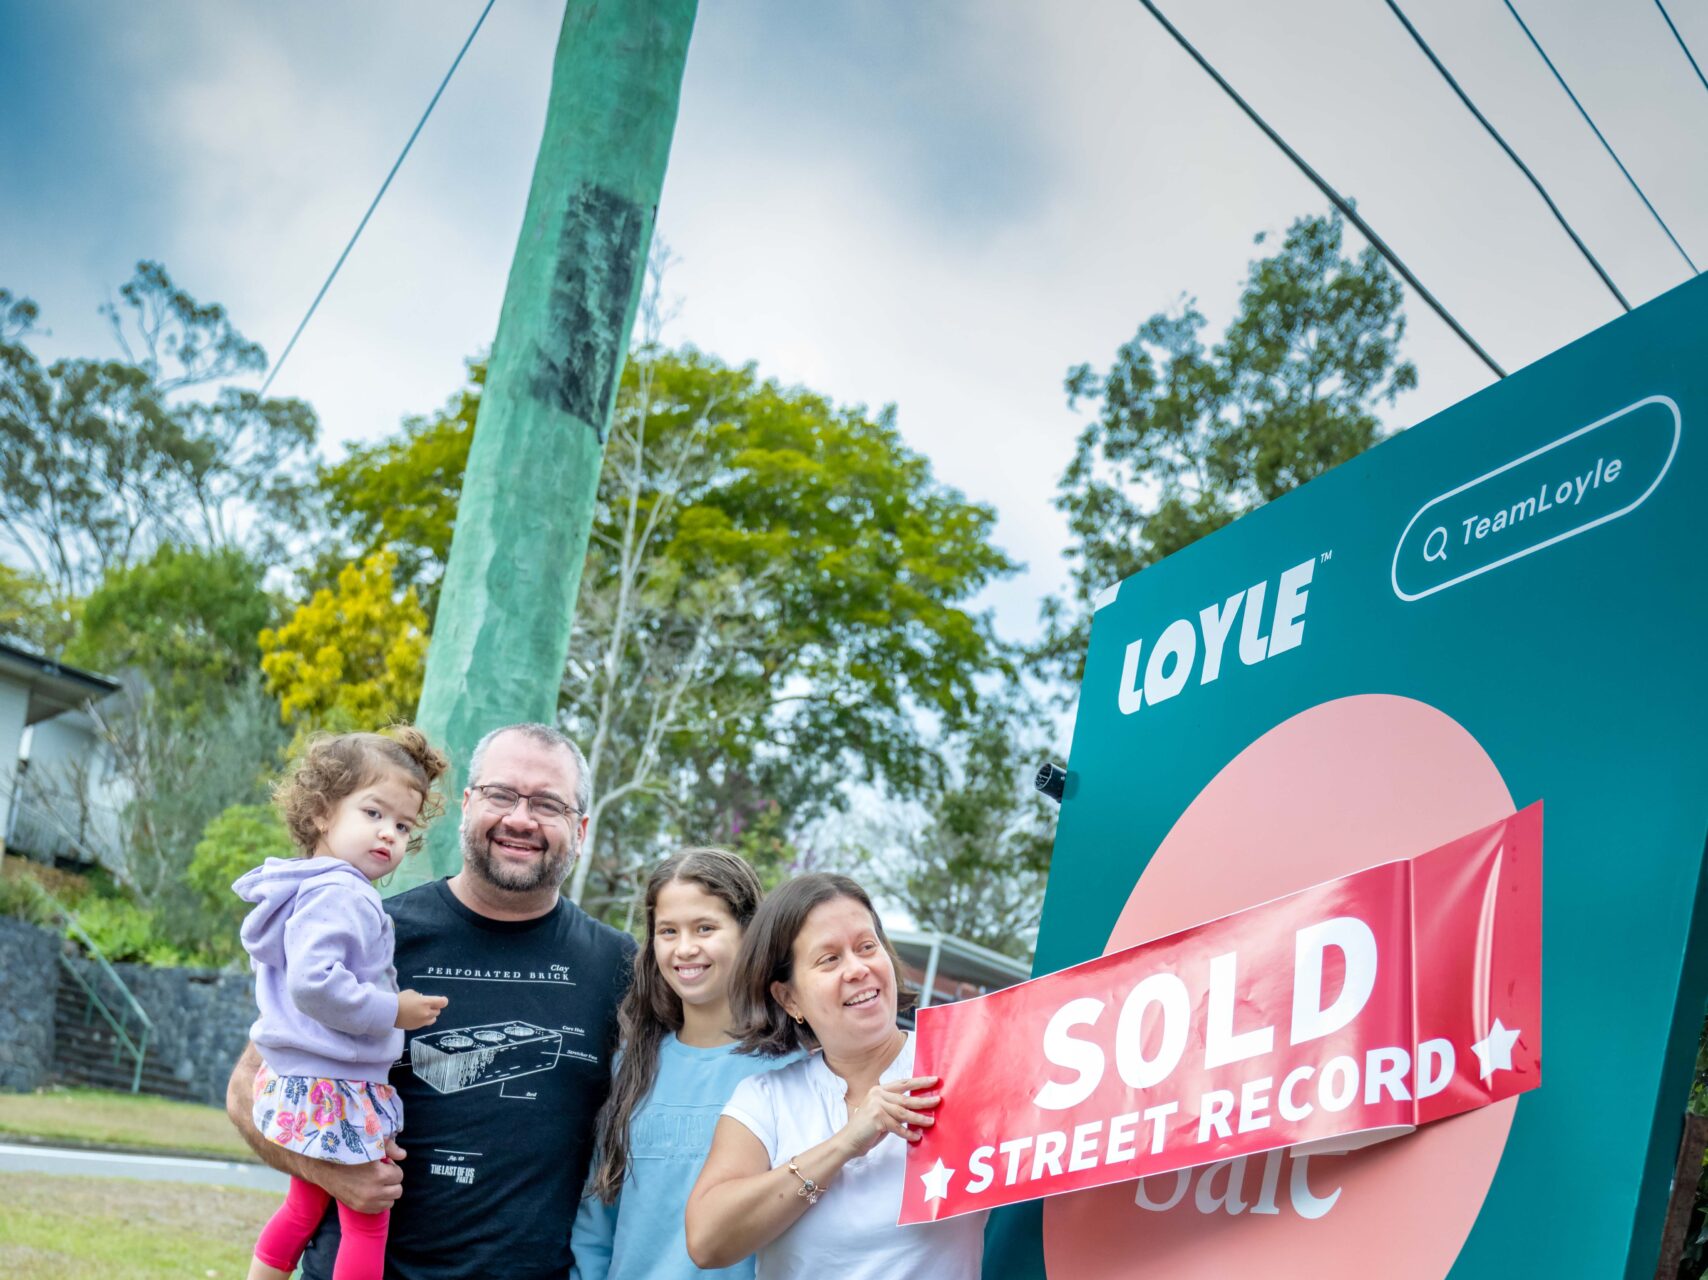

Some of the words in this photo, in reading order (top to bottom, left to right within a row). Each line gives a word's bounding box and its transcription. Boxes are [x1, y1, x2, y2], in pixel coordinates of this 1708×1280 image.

[1462, 457, 1623, 546] TeamLoyle
[1119, 556, 1316, 715] LOYLE
[427, 966, 521, 979] PERFORATED
[529, 972, 569, 981] BRICK
[550, 964, 570, 973] Clay
[1033, 916, 1378, 1111] SOLD
[965, 1101, 1178, 1195] STREET
[1197, 1038, 1456, 1144] RECORD
[431, 1164, 441, 1175] THE
[441, 1165, 457, 1177] LAST
